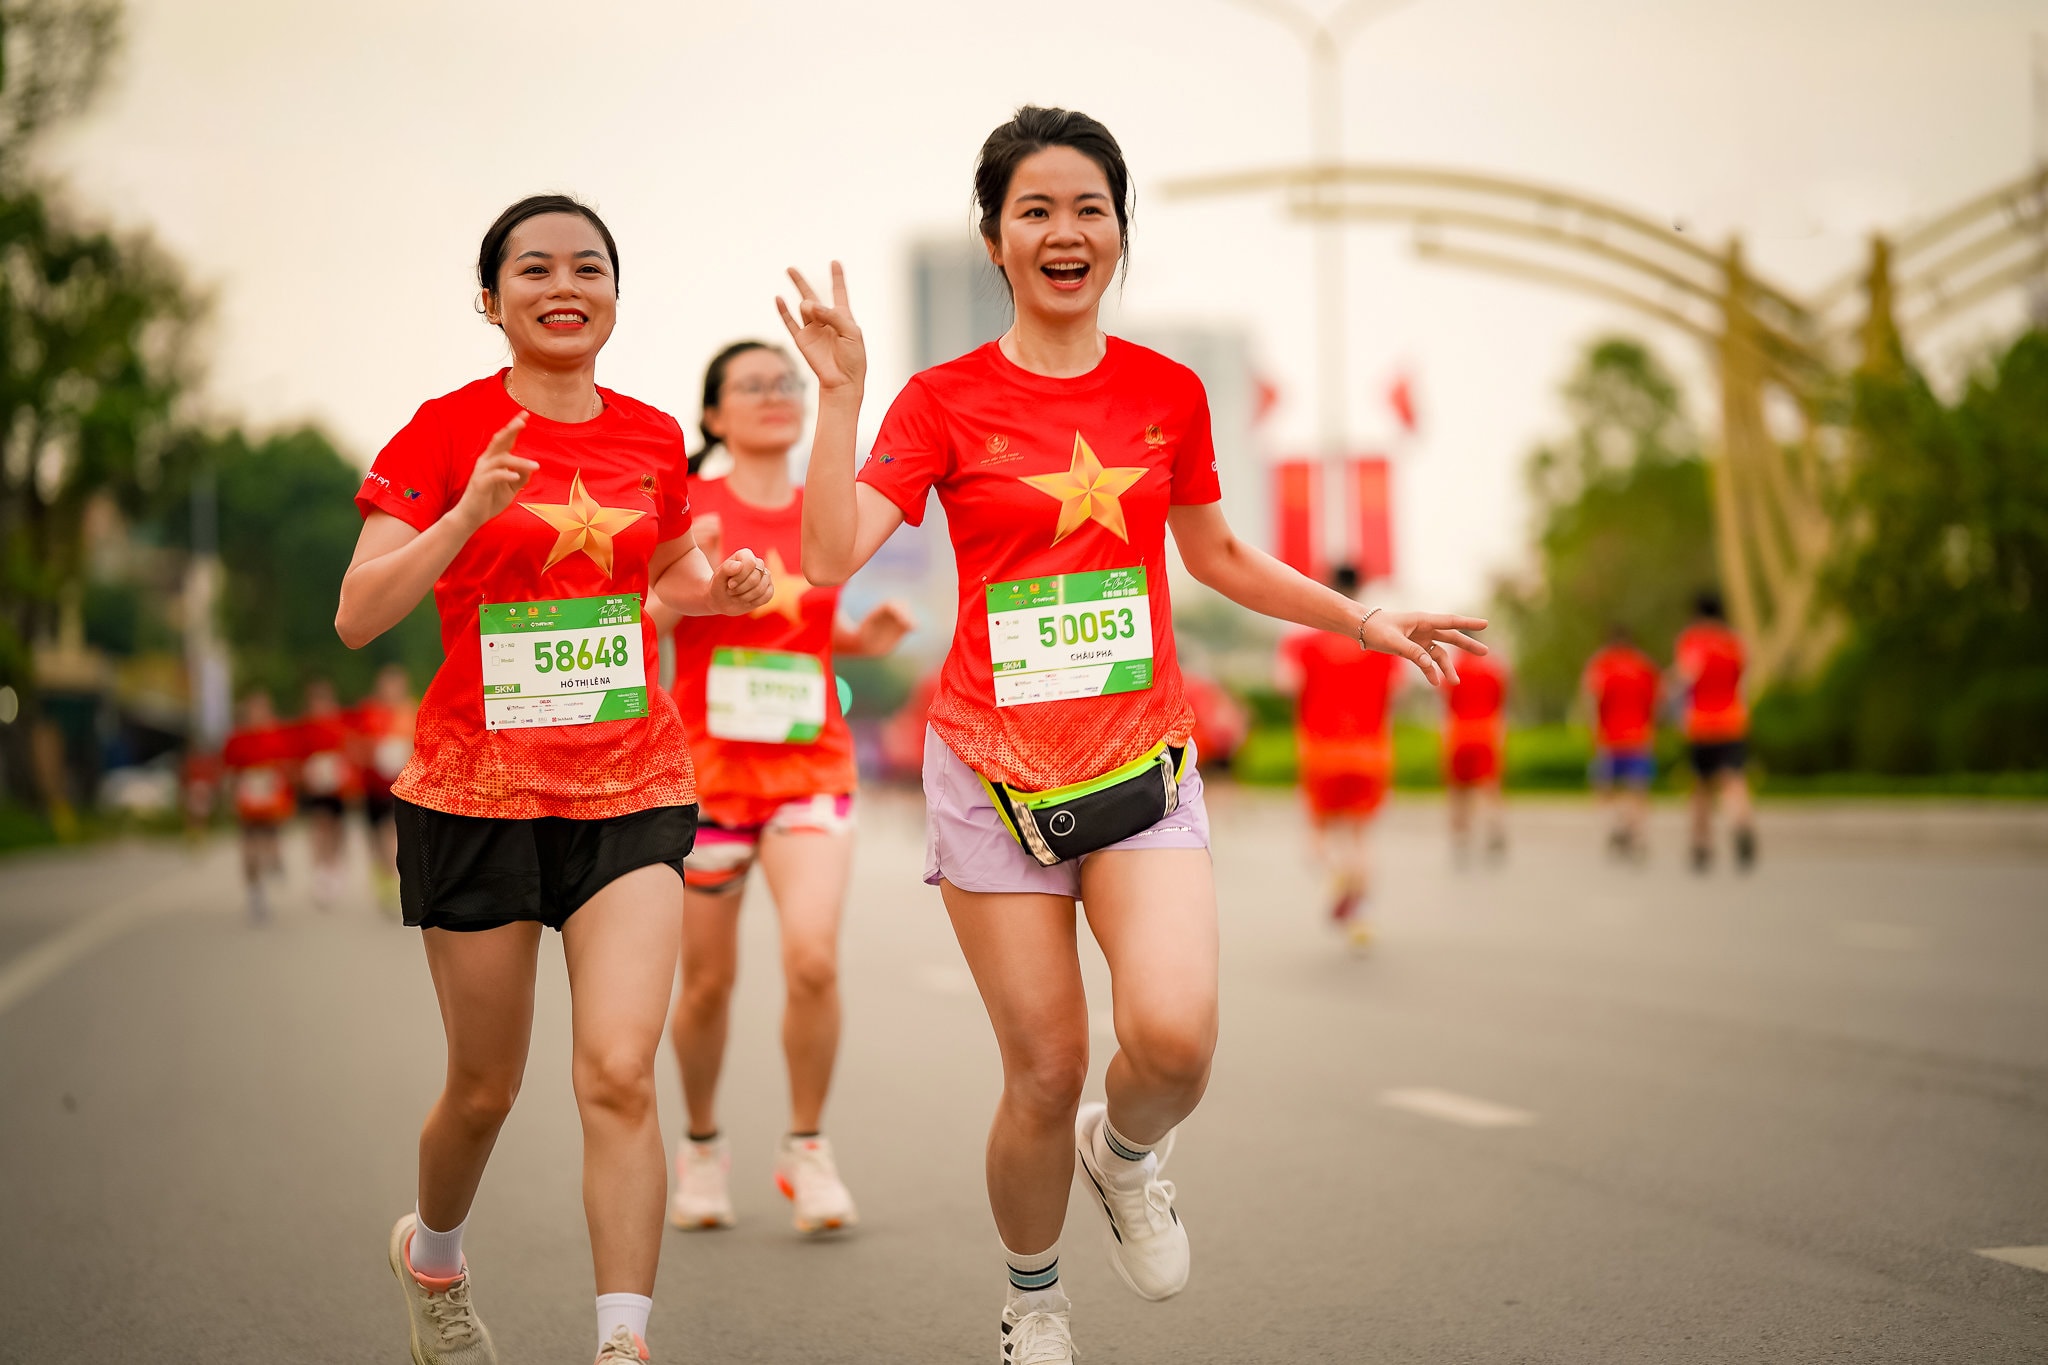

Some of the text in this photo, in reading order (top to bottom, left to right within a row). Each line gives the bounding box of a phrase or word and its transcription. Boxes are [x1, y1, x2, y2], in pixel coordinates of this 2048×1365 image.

[1038, 608, 1135, 648] 50053
[534, 635, 629, 673] 58648
[494, 685, 515, 694] 5KM
[590, 676, 599, 686] LÊ
[600, 676, 611, 685] NA
